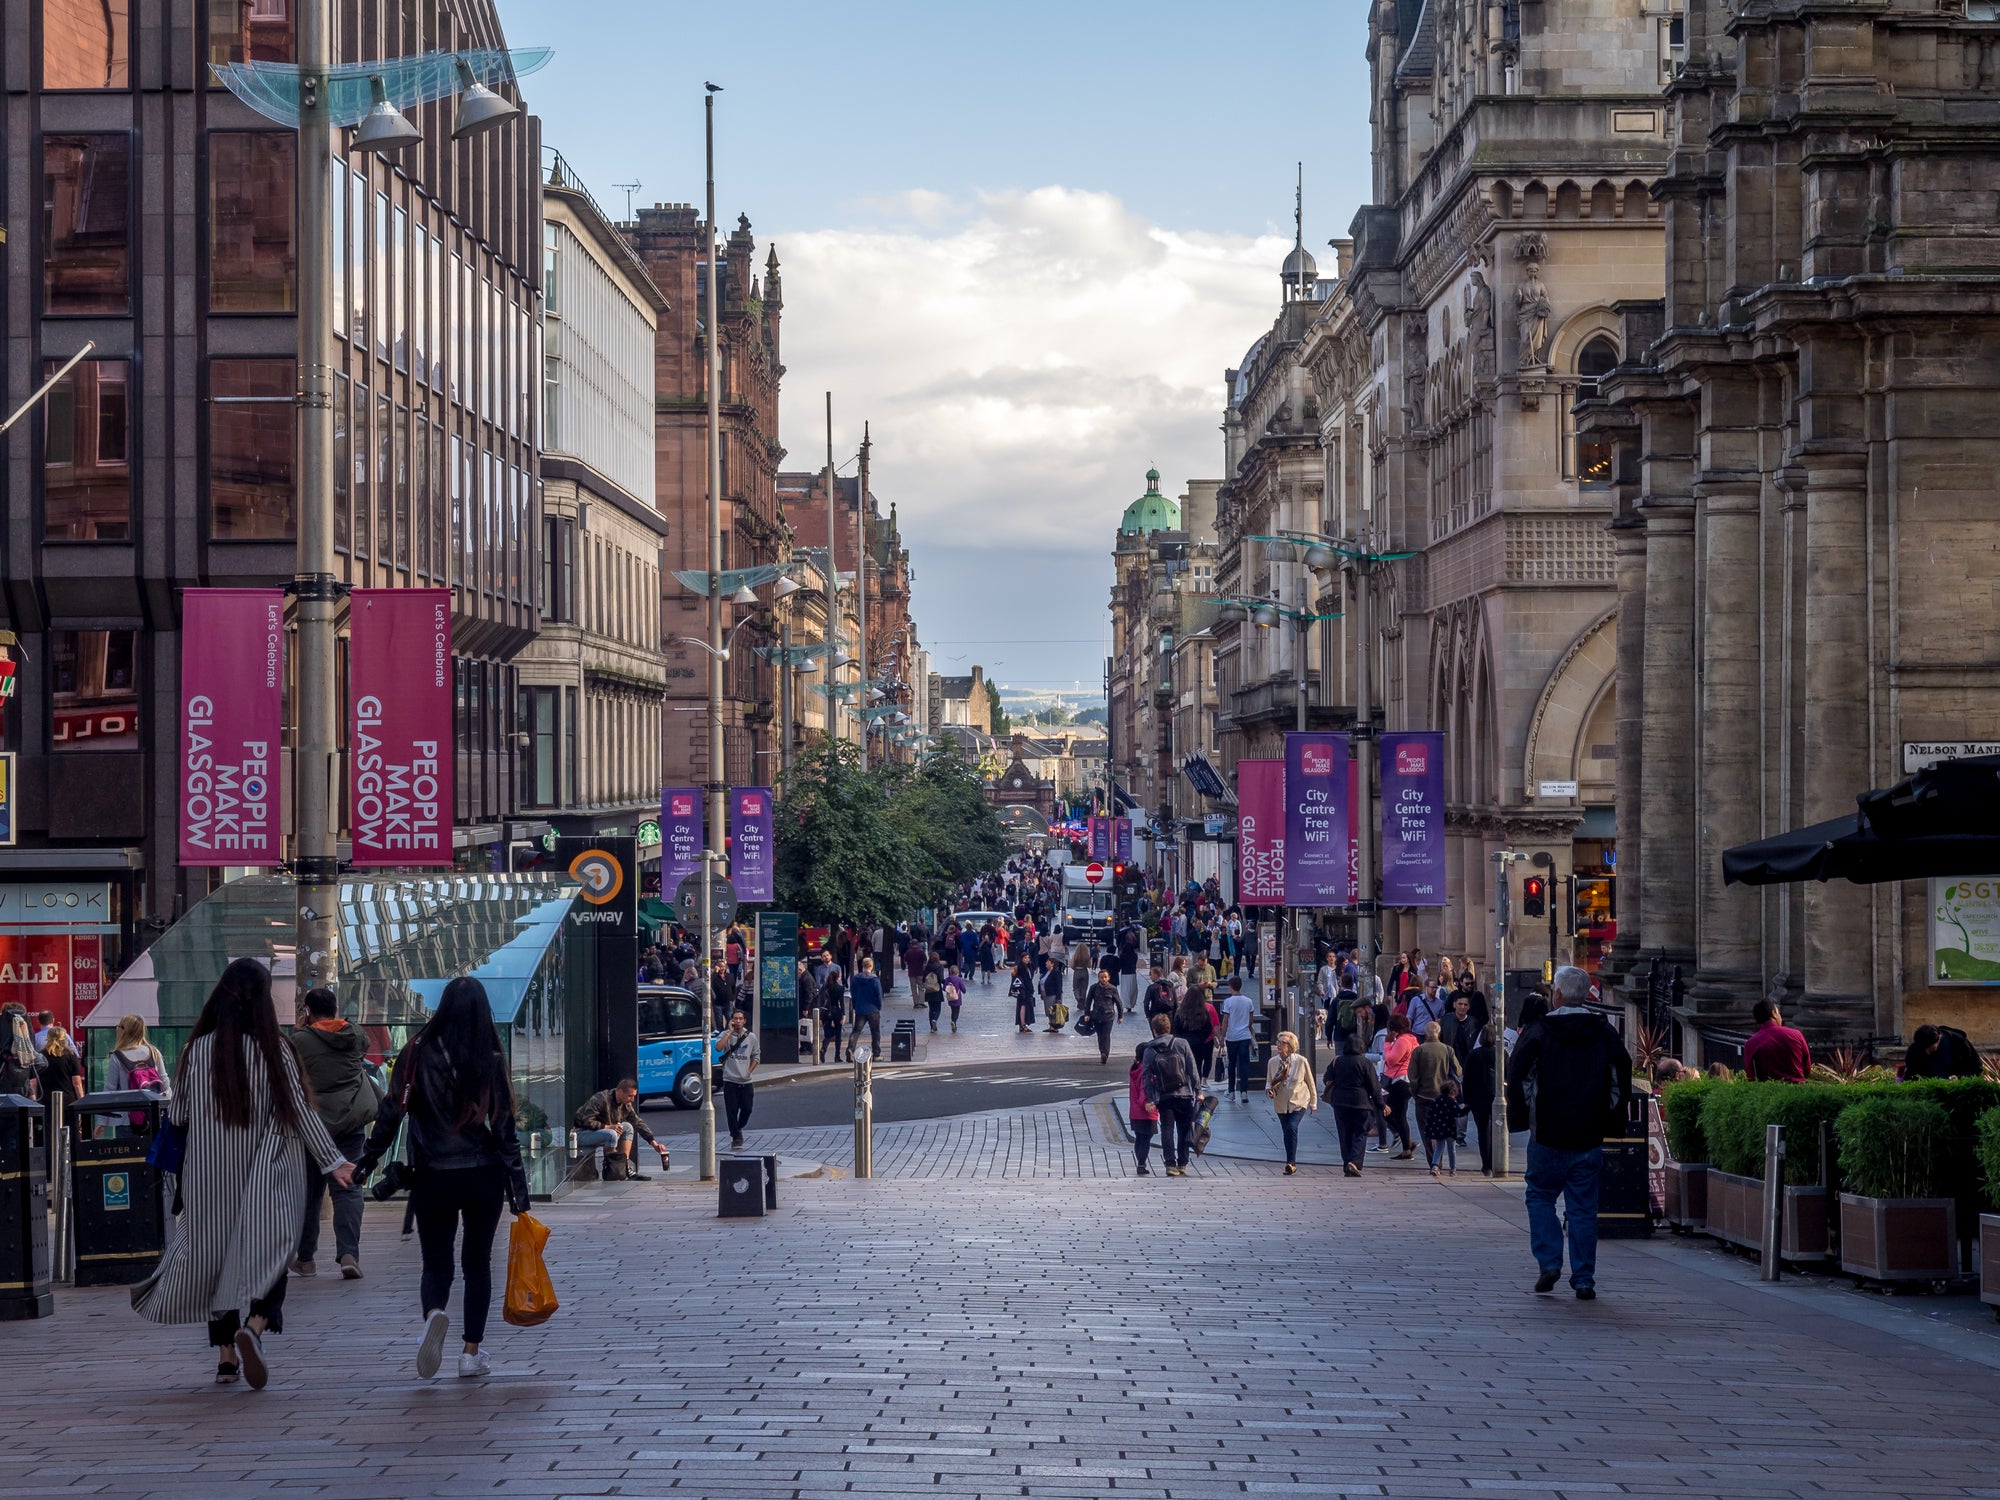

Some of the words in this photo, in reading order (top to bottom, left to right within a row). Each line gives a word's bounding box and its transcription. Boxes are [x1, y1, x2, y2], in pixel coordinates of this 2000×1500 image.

[268, 605, 278, 630] Let's
[435, 604, 445, 629] Let's
[267, 633, 277, 688] Celebrate
[435, 632, 445, 687] Celebrate
[1909, 745, 1957, 755] NELSON
[187, 695, 213, 849] GLASGOW
[357, 695, 383, 849] GLASGOW
[242, 741, 267, 849] PEOPLE
[413, 740, 438, 849] PEOPLE
[1306, 789, 1328, 802] City
[1402, 789, 1424, 802] City
[214, 764, 239, 849] MAKE
[385, 764, 410, 849] MAKE
[1299, 803, 1335, 814] Centre
[1395, 803, 1431, 814] Centre
[1305, 817, 1329, 828] Free
[1401, 816, 1426, 828] Free
[675, 825, 690, 834] City
[744, 825, 759, 834] City
[670, 834, 695, 842] Centre
[740, 834, 764, 842] Centre
[1305, 831, 1329, 842] WiFi
[1401, 830, 1426, 842] WiFi
[674, 843, 691, 851] Free
[743, 843, 760, 851] Free
[674, 852, 691, 860] WiFi
[743, 852, 760, 860] WiFi
[1242, 815, 1256, 896] GLASGOW
[1257, 851, 1270, 897] MAKE
[1270, 839, 1284, 897] PEOPLE
[1317, 884, 1335, 895] wifi
[1415, 884, 1433, 895] wifi
[25, 892, 102, 908] LOOK
[98, 1146, 130, 1154] LITTER
